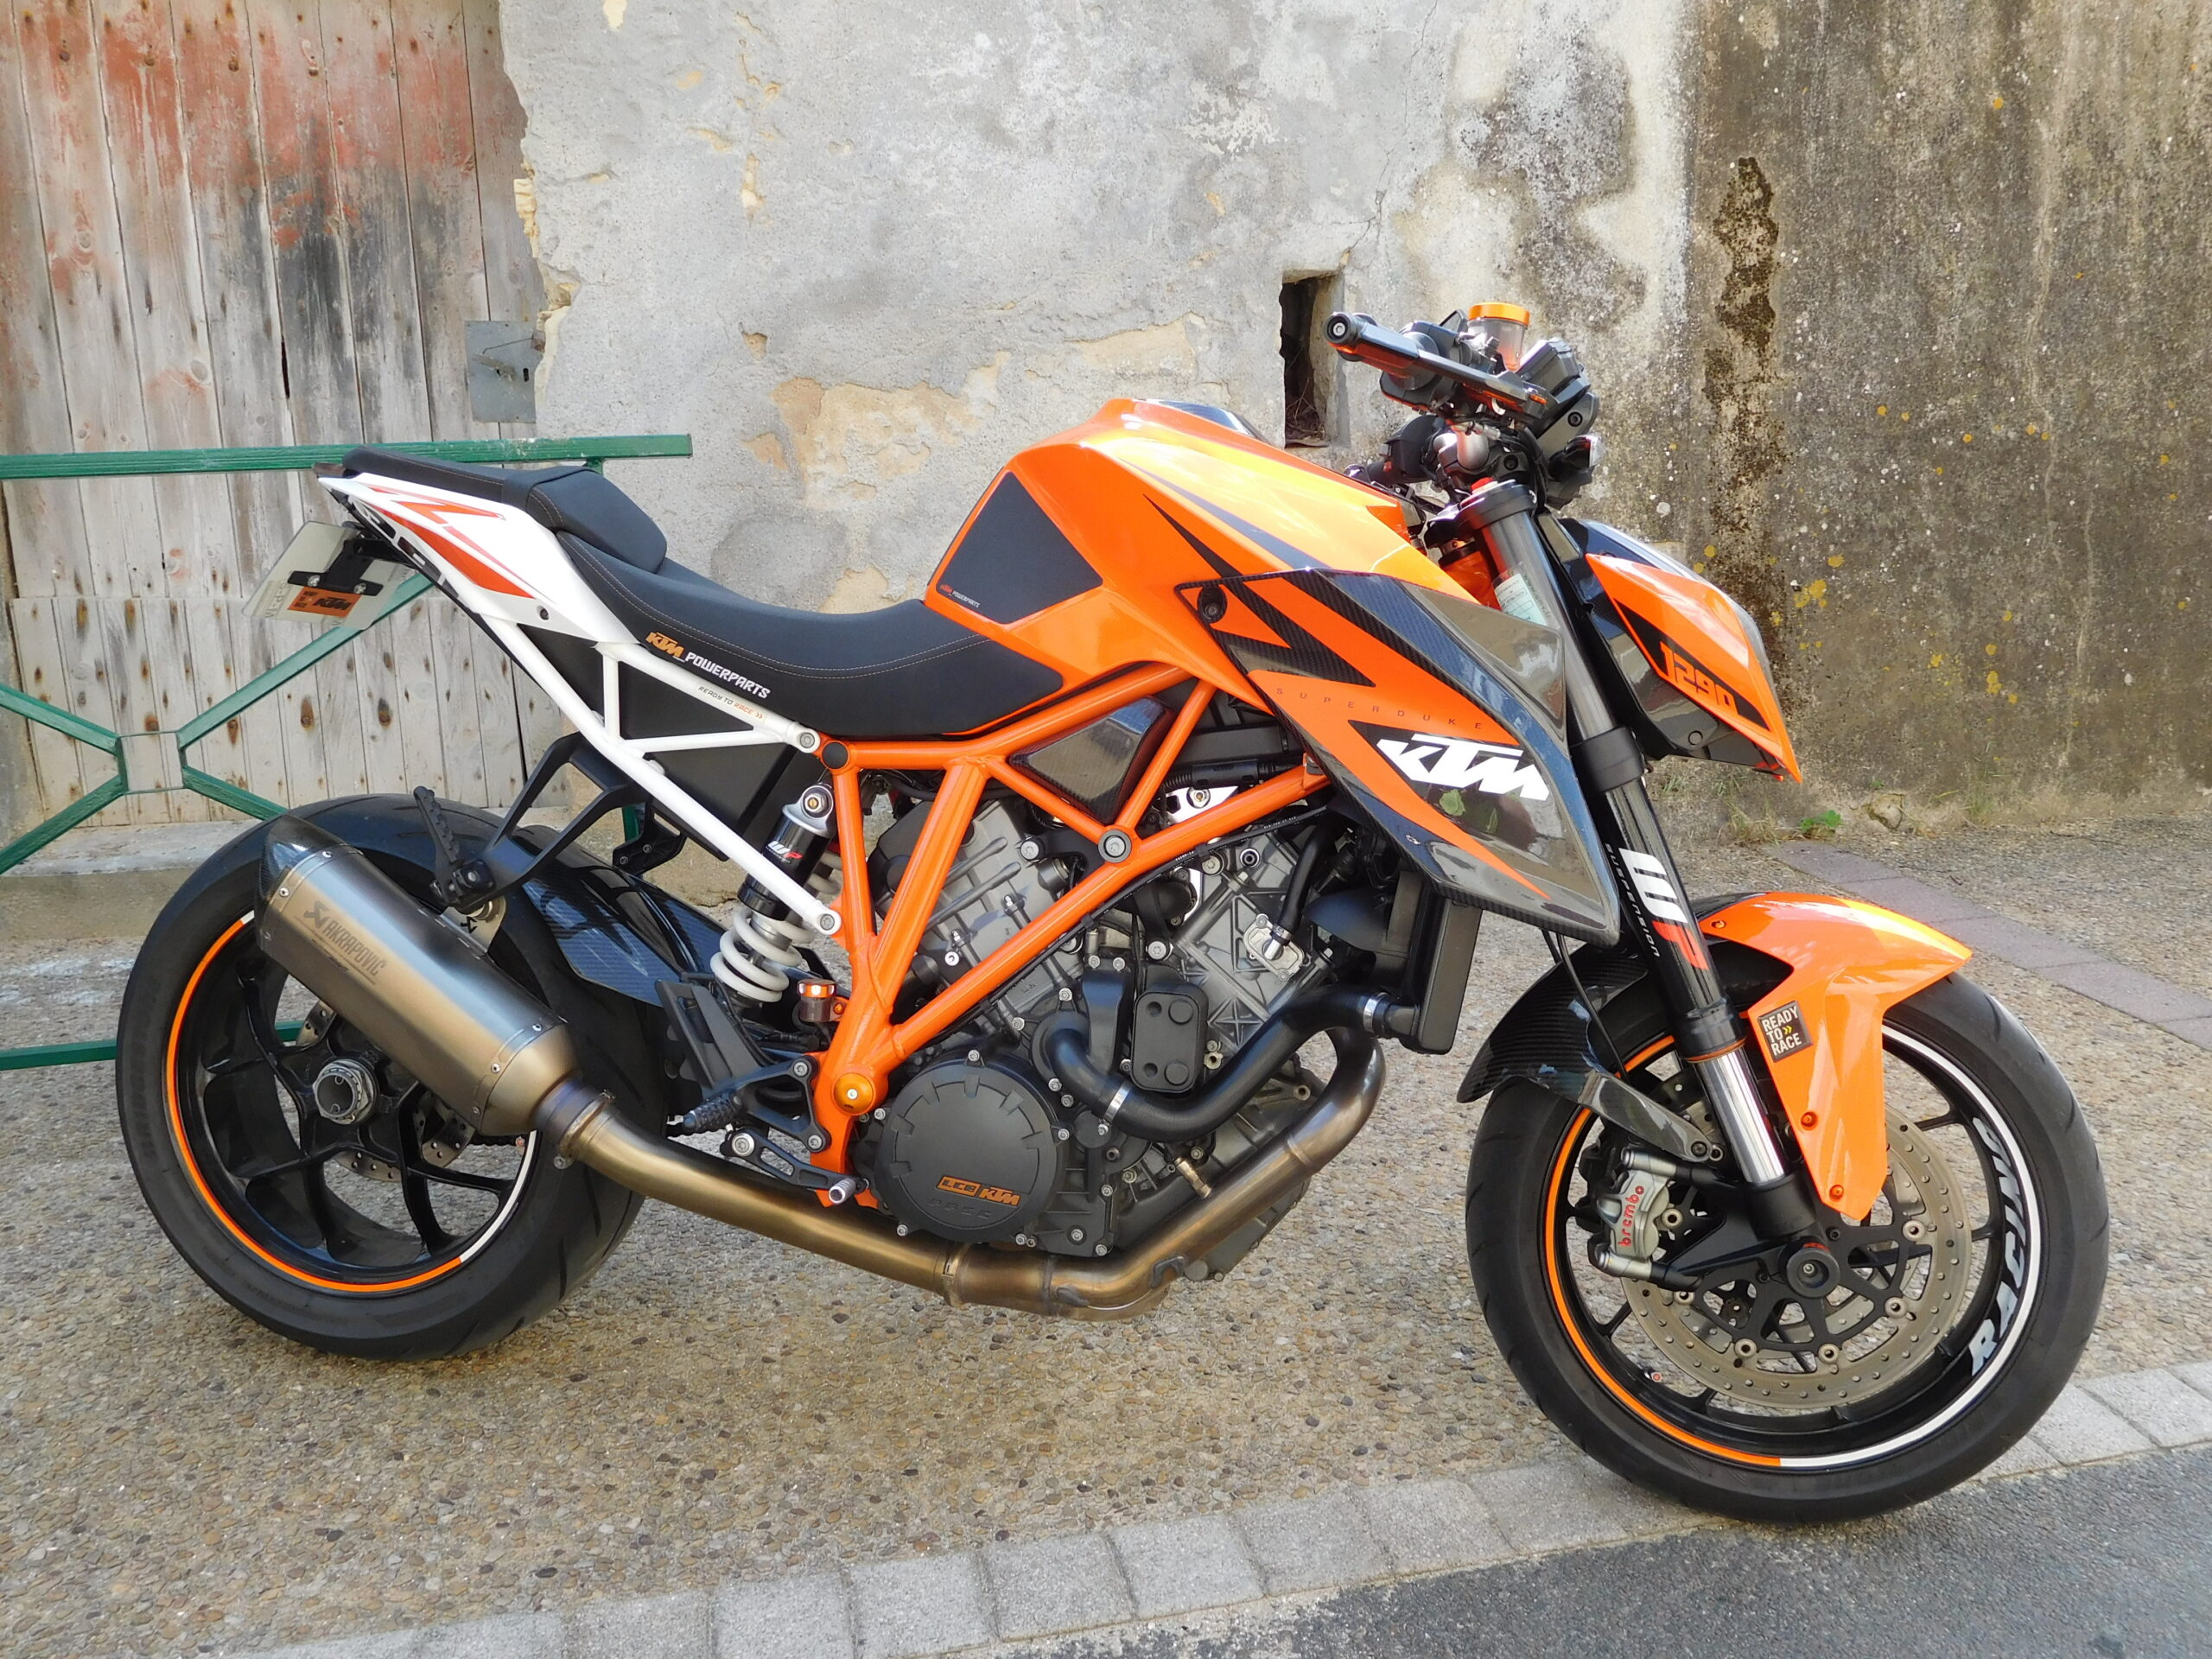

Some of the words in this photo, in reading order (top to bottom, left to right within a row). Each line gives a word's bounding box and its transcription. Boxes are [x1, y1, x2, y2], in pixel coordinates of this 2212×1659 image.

[645, 632, 684, 658] KTM
[684, 652, 772, 699] POWERPARTS
[1660, 641, 1739, 715] 1290
[698, 686, 722, 701] READY
[734, 702, 753, 715] RACE
[1376, 734, 1550, 802] KTM
[767, 841, 803, 860] WP
[1605, 843, 1661, 957] SUSPENSION
[1618, 848, 1709, 969] WP
[1762, 1006, 1798, 1032] READY
[1766, 1028, 1783, 1043] TO
[1770, 1033, 1802, 1056] RACE
[979, 1187, 1020, 1206] KTM
[1618, 1185, 1644, 1247] brembo
